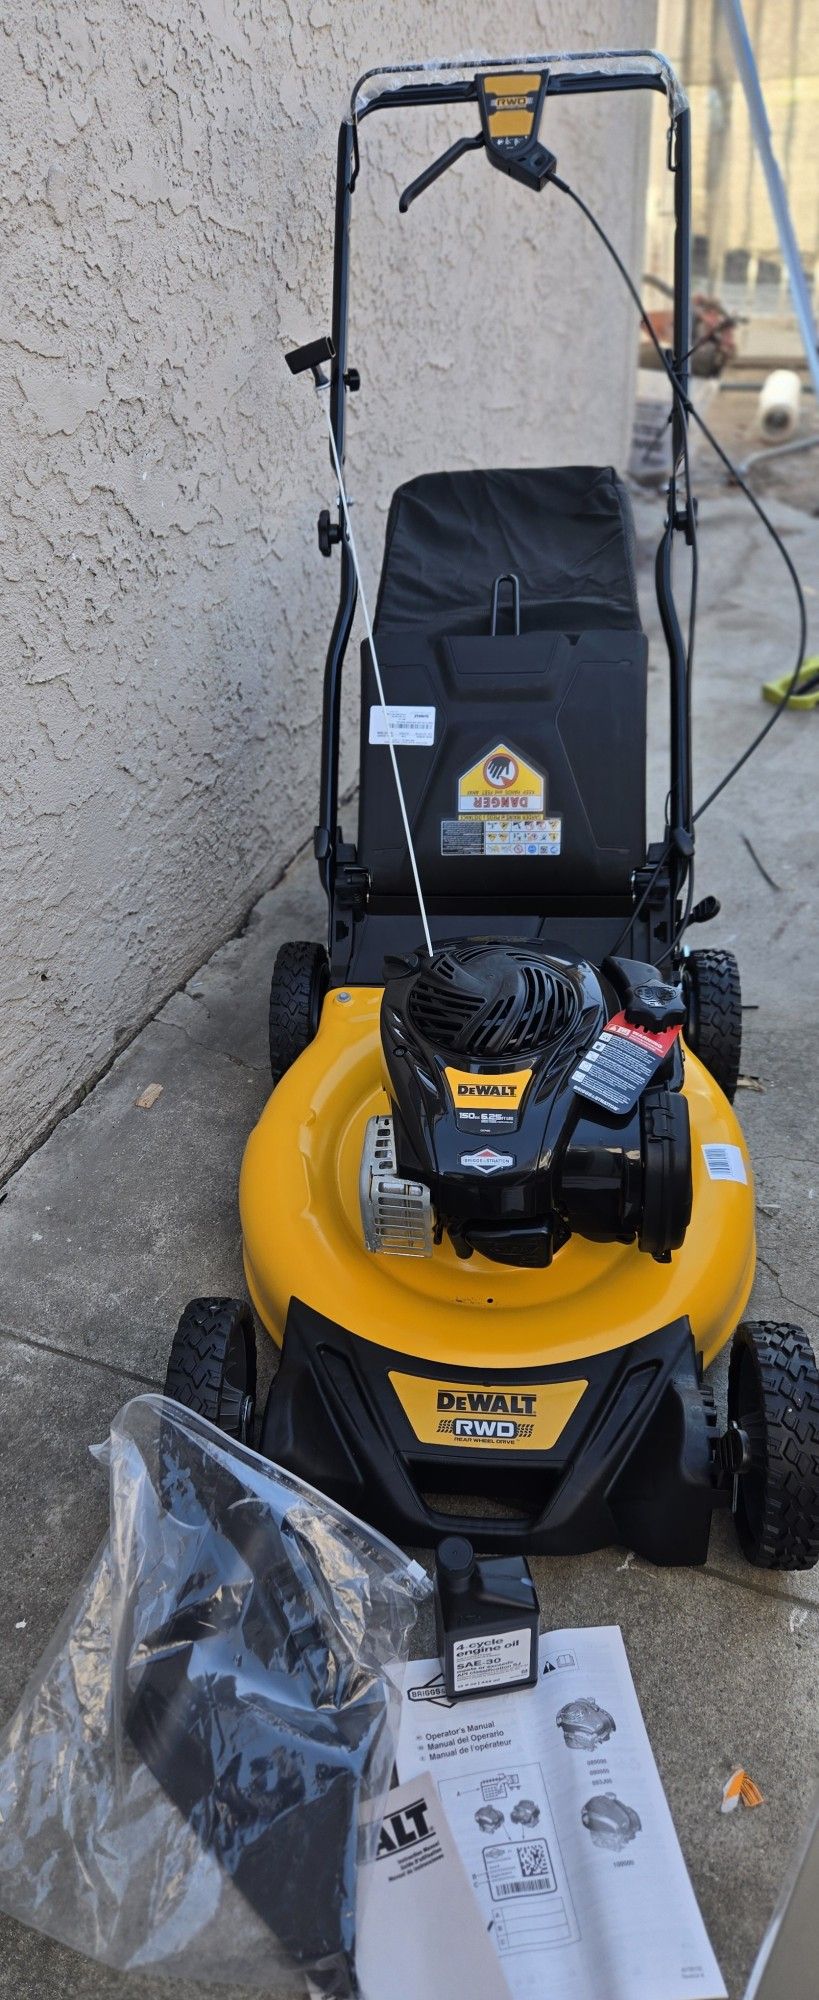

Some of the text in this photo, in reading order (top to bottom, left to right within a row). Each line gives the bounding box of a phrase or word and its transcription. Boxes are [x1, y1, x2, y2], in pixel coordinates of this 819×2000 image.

[497, 97, 526, 106] RWD
[473, 797, 528, 808] DANGER
[455, 1419, 515, 1437] RWD
[456, 1640, 519, 1657] engine oil
[411, 1688, 440, 1698] BRIGGS
[425, 1720, 495, 1740] Operator's Manual
[427, 1739, 455, 1750] Manual
[457, 1735, 469, 1744] del
[470, 1729, 504, 1741] Operario
[429, 1749, 458, 1760] Manual
[459, 1746, 469, 1754] de
[376, 1801, 428, 1856] ALT
